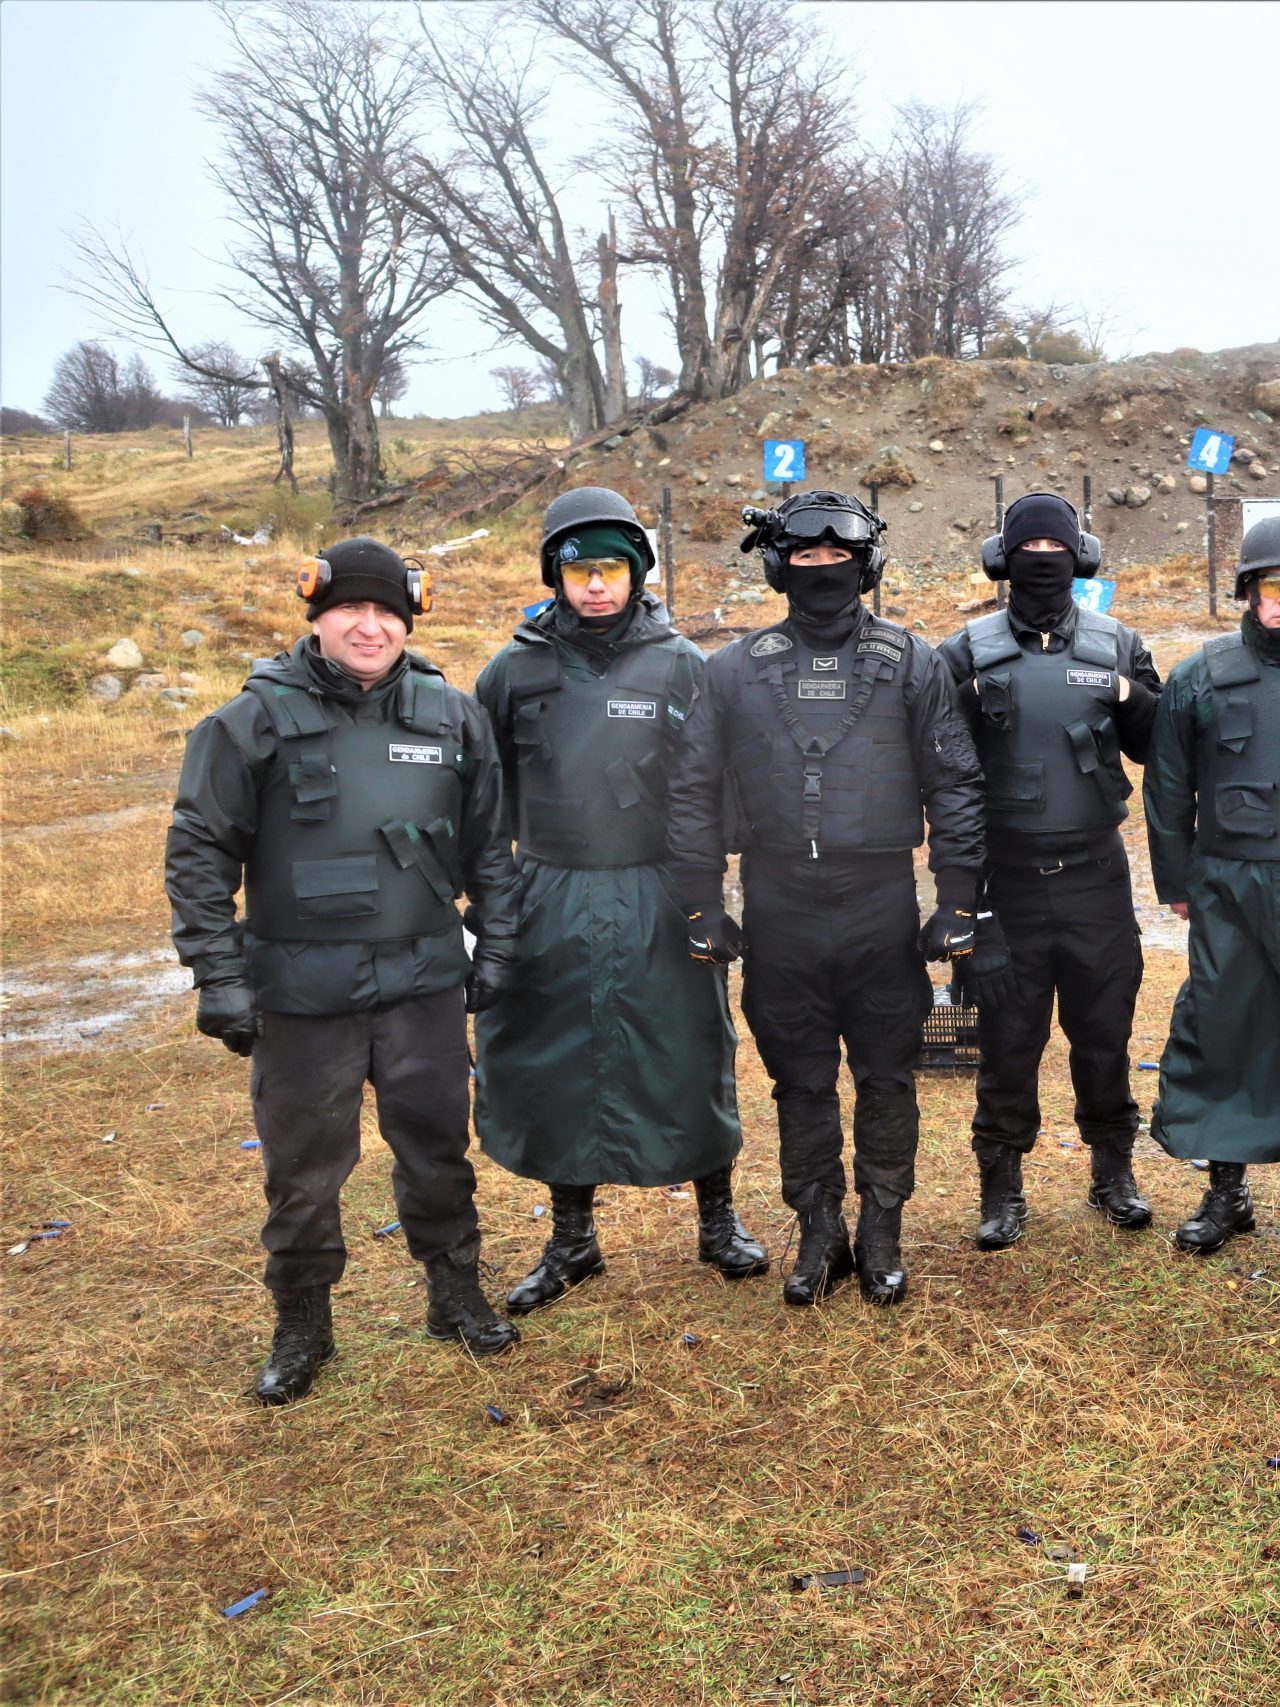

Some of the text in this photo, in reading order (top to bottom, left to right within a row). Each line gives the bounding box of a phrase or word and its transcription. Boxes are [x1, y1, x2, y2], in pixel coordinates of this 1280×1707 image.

[1199, 434, 1222, 468] 4
[774, 444, 795, 478] 2
[1079, 580, 1103, 611] 3
[1070, 672, 1108, 680] GENDARMERIA
[802, 682, 842, 690] GENDARMERIA
[611, 702, 652, 711] GENDARMERIA
[392, 746, 439, 756] GENDARMERIA
